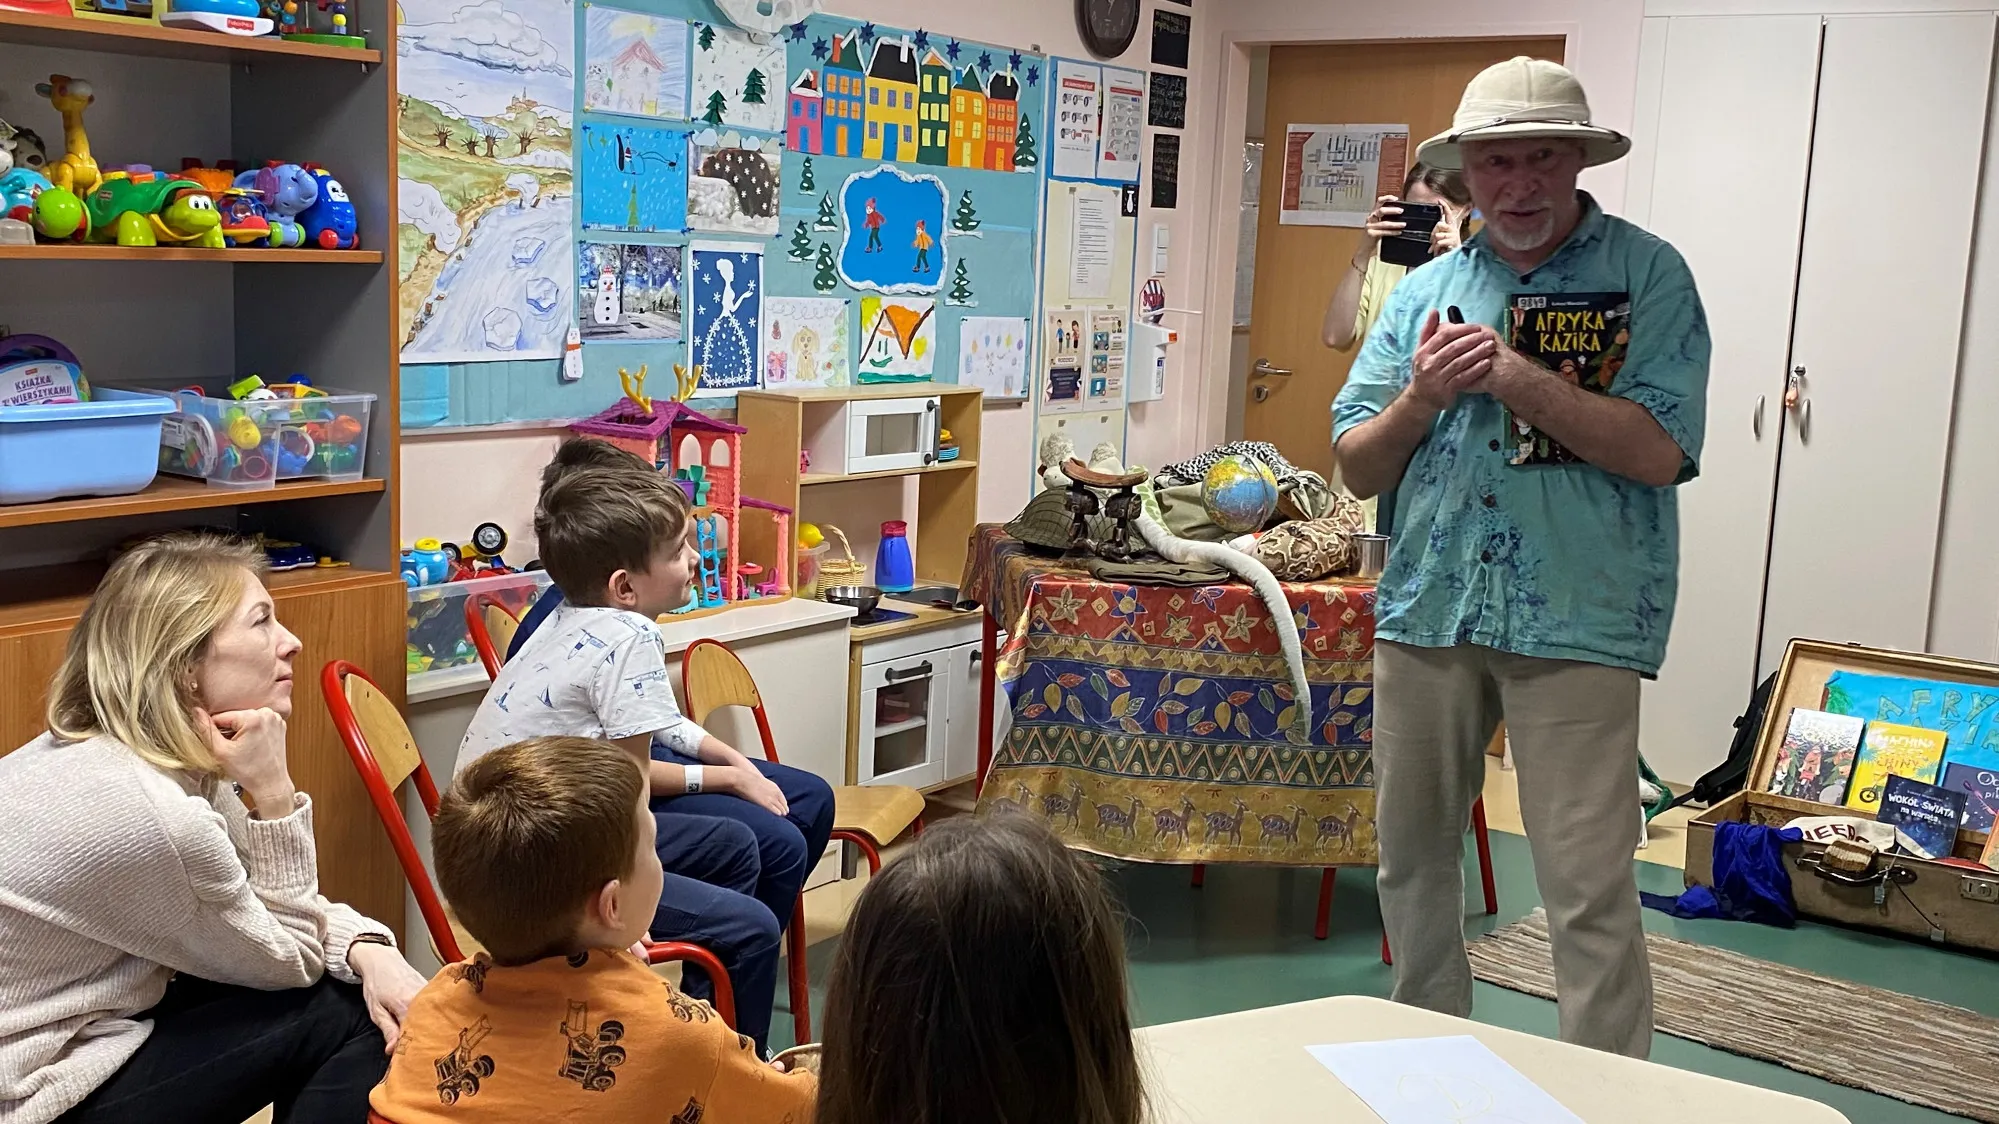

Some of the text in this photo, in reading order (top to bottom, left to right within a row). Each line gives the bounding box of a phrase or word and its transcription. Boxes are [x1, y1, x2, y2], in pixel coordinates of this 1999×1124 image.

[1536, 310, 1605, 332] AFRYKA
[1540, 331, 1601, 353] KAZIKA
[10, 385, 70, 405] WIERSZYKAMI
[1878, 689, 1999, 722] AFRY
[1900, 806, 1909, 814] na
